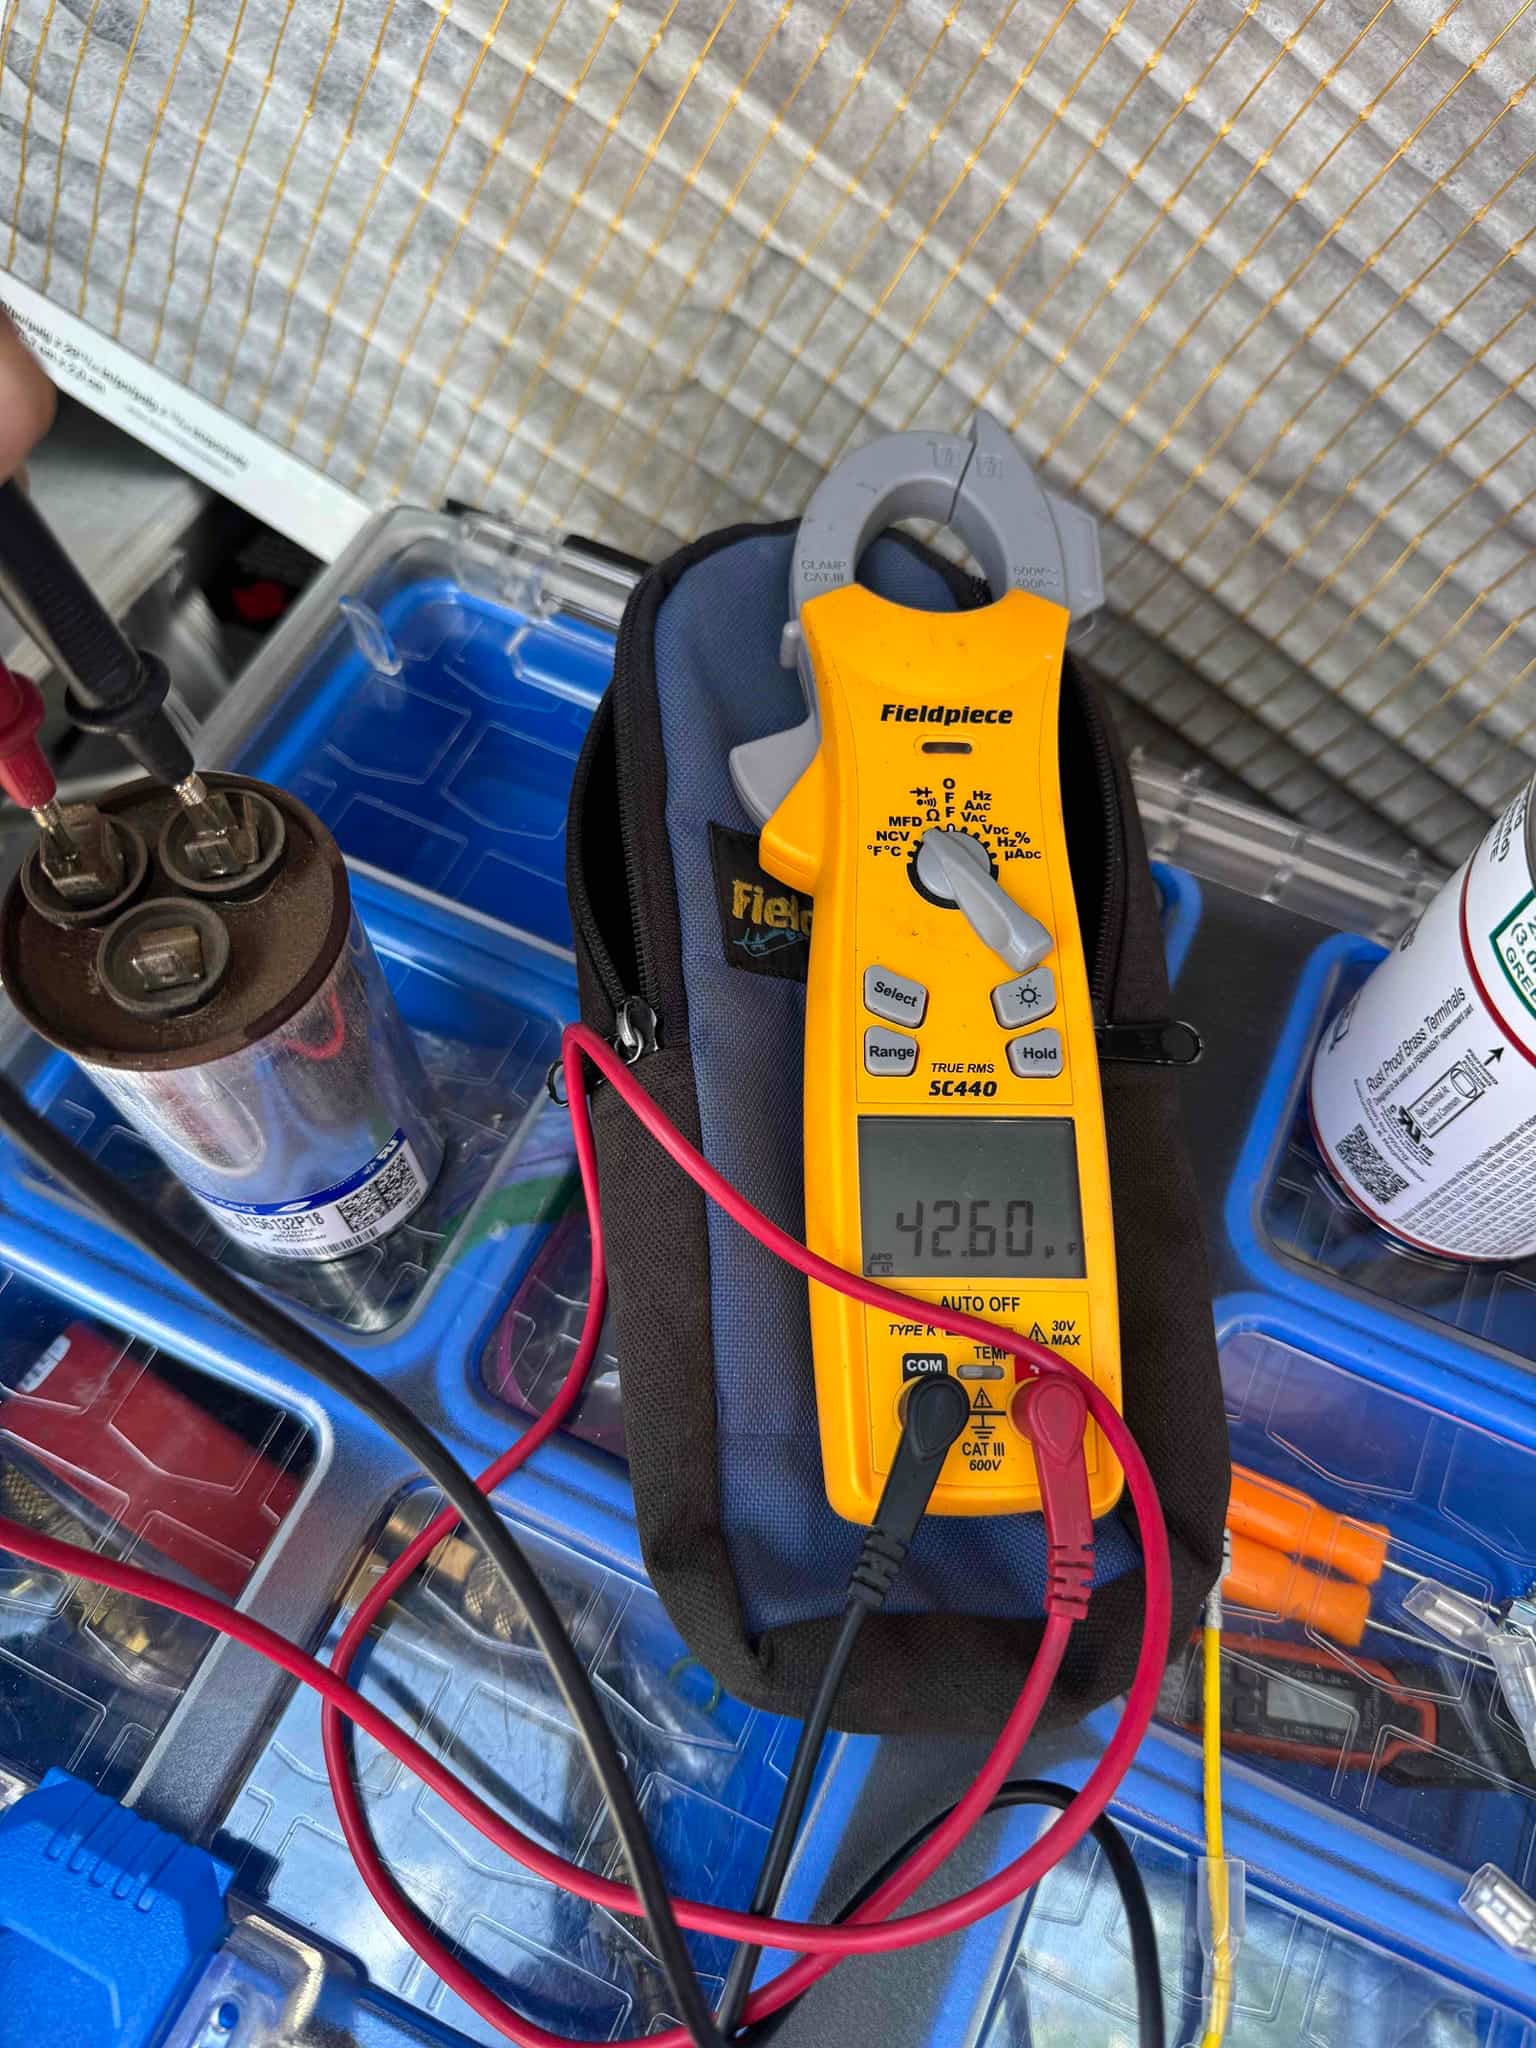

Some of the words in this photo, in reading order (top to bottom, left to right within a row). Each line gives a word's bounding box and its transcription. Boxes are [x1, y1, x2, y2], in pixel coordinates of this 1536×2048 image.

[801, 560, 847, 569] CLAMP
[880, 704, 1013, 726] Fieldpiece
[972, 790, 992, 801] Hz
[888, 816, 923, 827] MFD
[876, 831, 910, 841] NCV
[997, 837, 1017, 848] Hz
[873, 981, 919, 1008] Select
[1366, 1066, 1387, 1094] Rust
[1382, 1045, 1405, 1077] Proof
[1402, 1027, 1427, 1057] Brass
[1423, 985, 1466, 1033] Terminals
[869, 1045, 914, 1060] Range
[1023, 1047, 1057, 1060] Hold
[931, 1063, 963, 1073] TRUE
[967, 1063, 995, 1074] RMS
[929, 1080, 997, 1097] SC440
[896, 1200, 1034, 1257] 42.60
[940, 1296, 984, 1312] AUTO
[989, 1297, 1020, 1312] OFF
[889, 1324, 922, 1336] TYPE
[926, 1325, 936, 1336] K
[1052, 1321, 1076, 1332] 30V
[1051, 1334, 1080, 1345] MAX
[906, 1359, 943, 1372] COM
[962, 1442, 990, 1457] CAT
[993, 1442, 1004, 1457] III
[969, 1460, 1002, 1471] 600V
